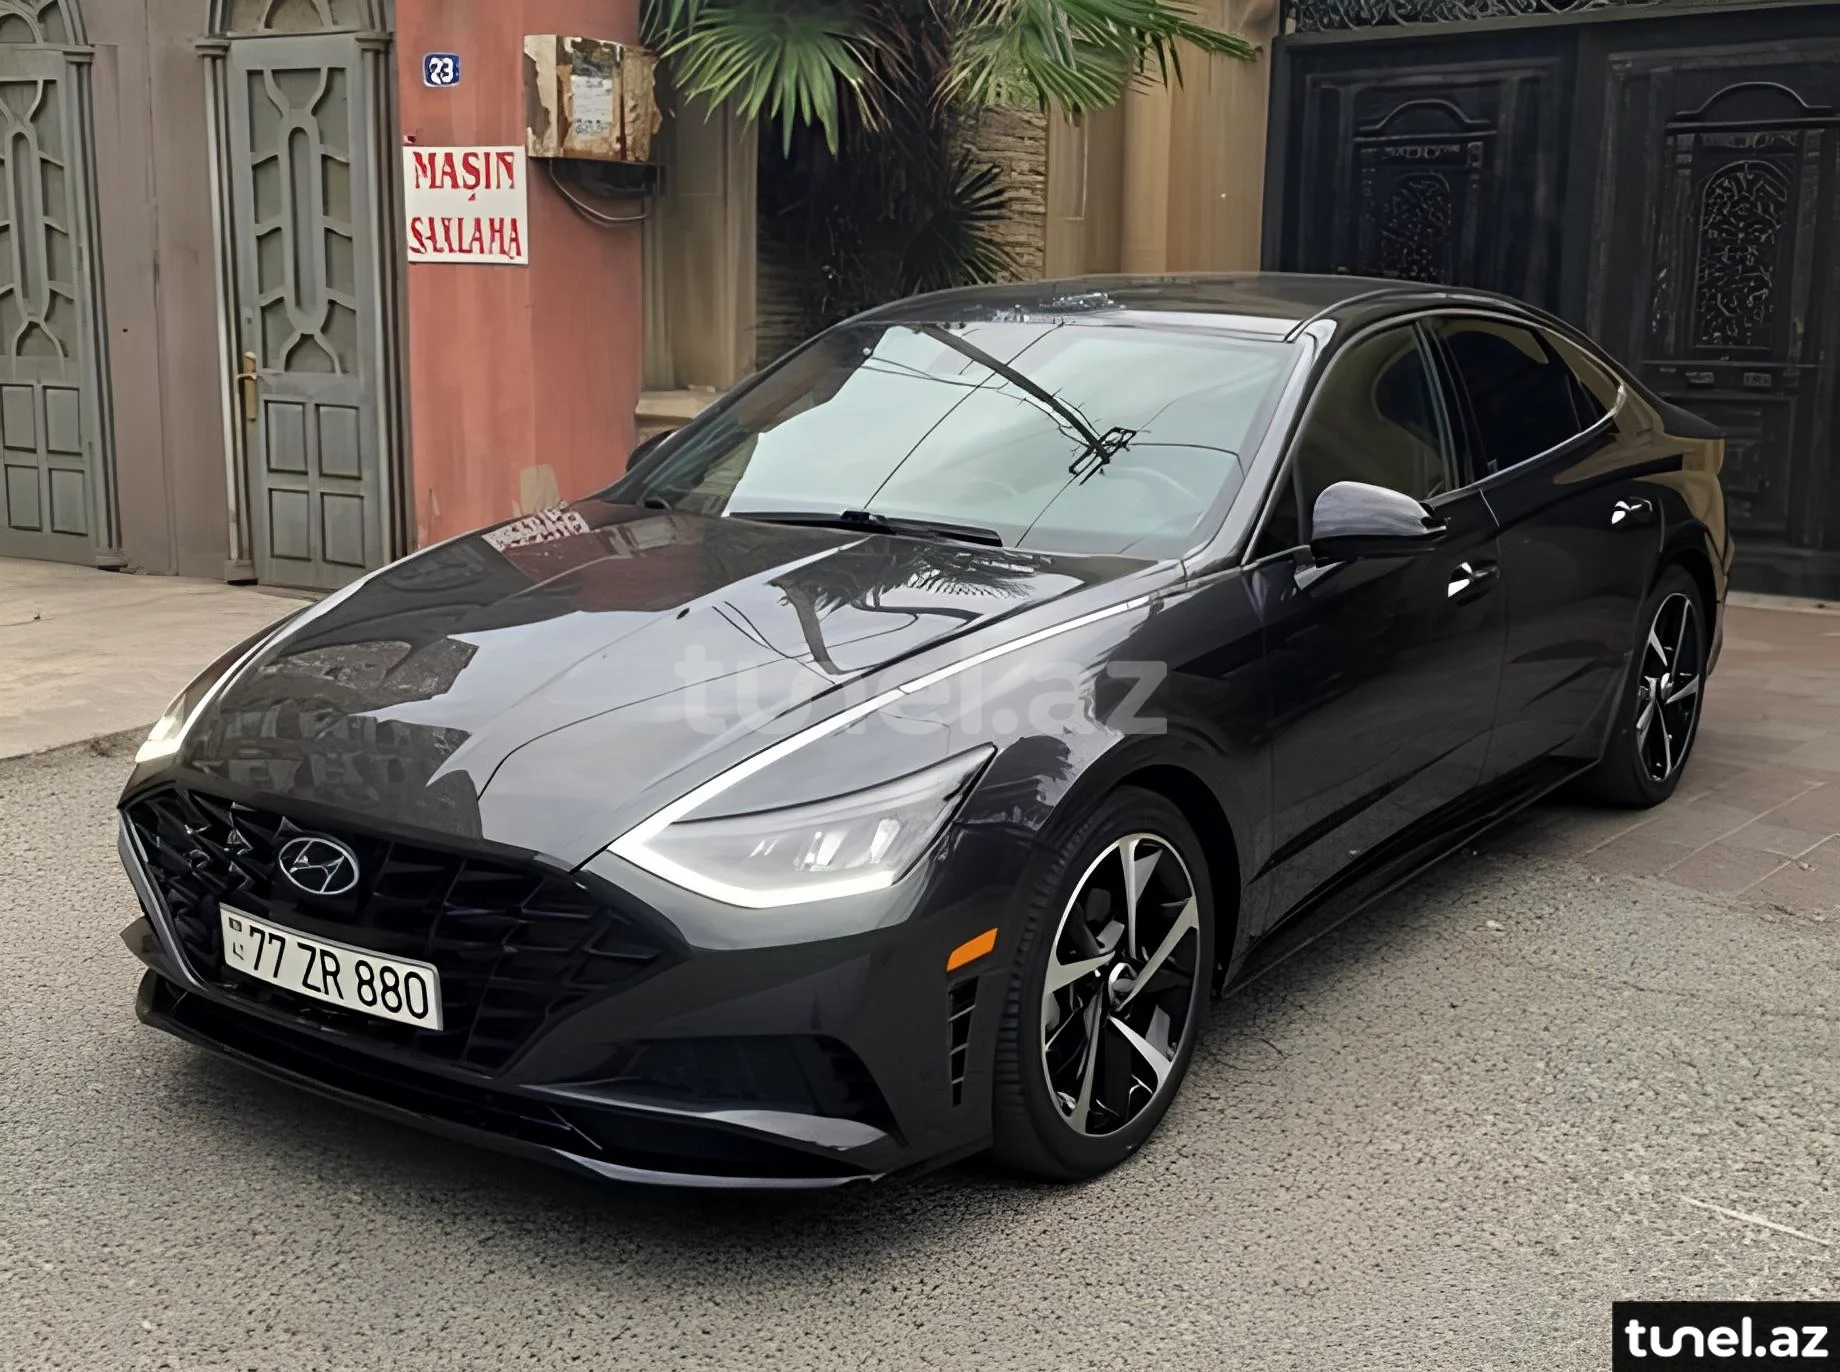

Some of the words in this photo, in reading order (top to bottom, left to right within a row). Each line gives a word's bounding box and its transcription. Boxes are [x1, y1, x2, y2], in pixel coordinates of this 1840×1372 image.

[249, 924, 286, 979] 77
[297, 941, 344, 1000] ZR
[354, 959, 429, 1020] 880
